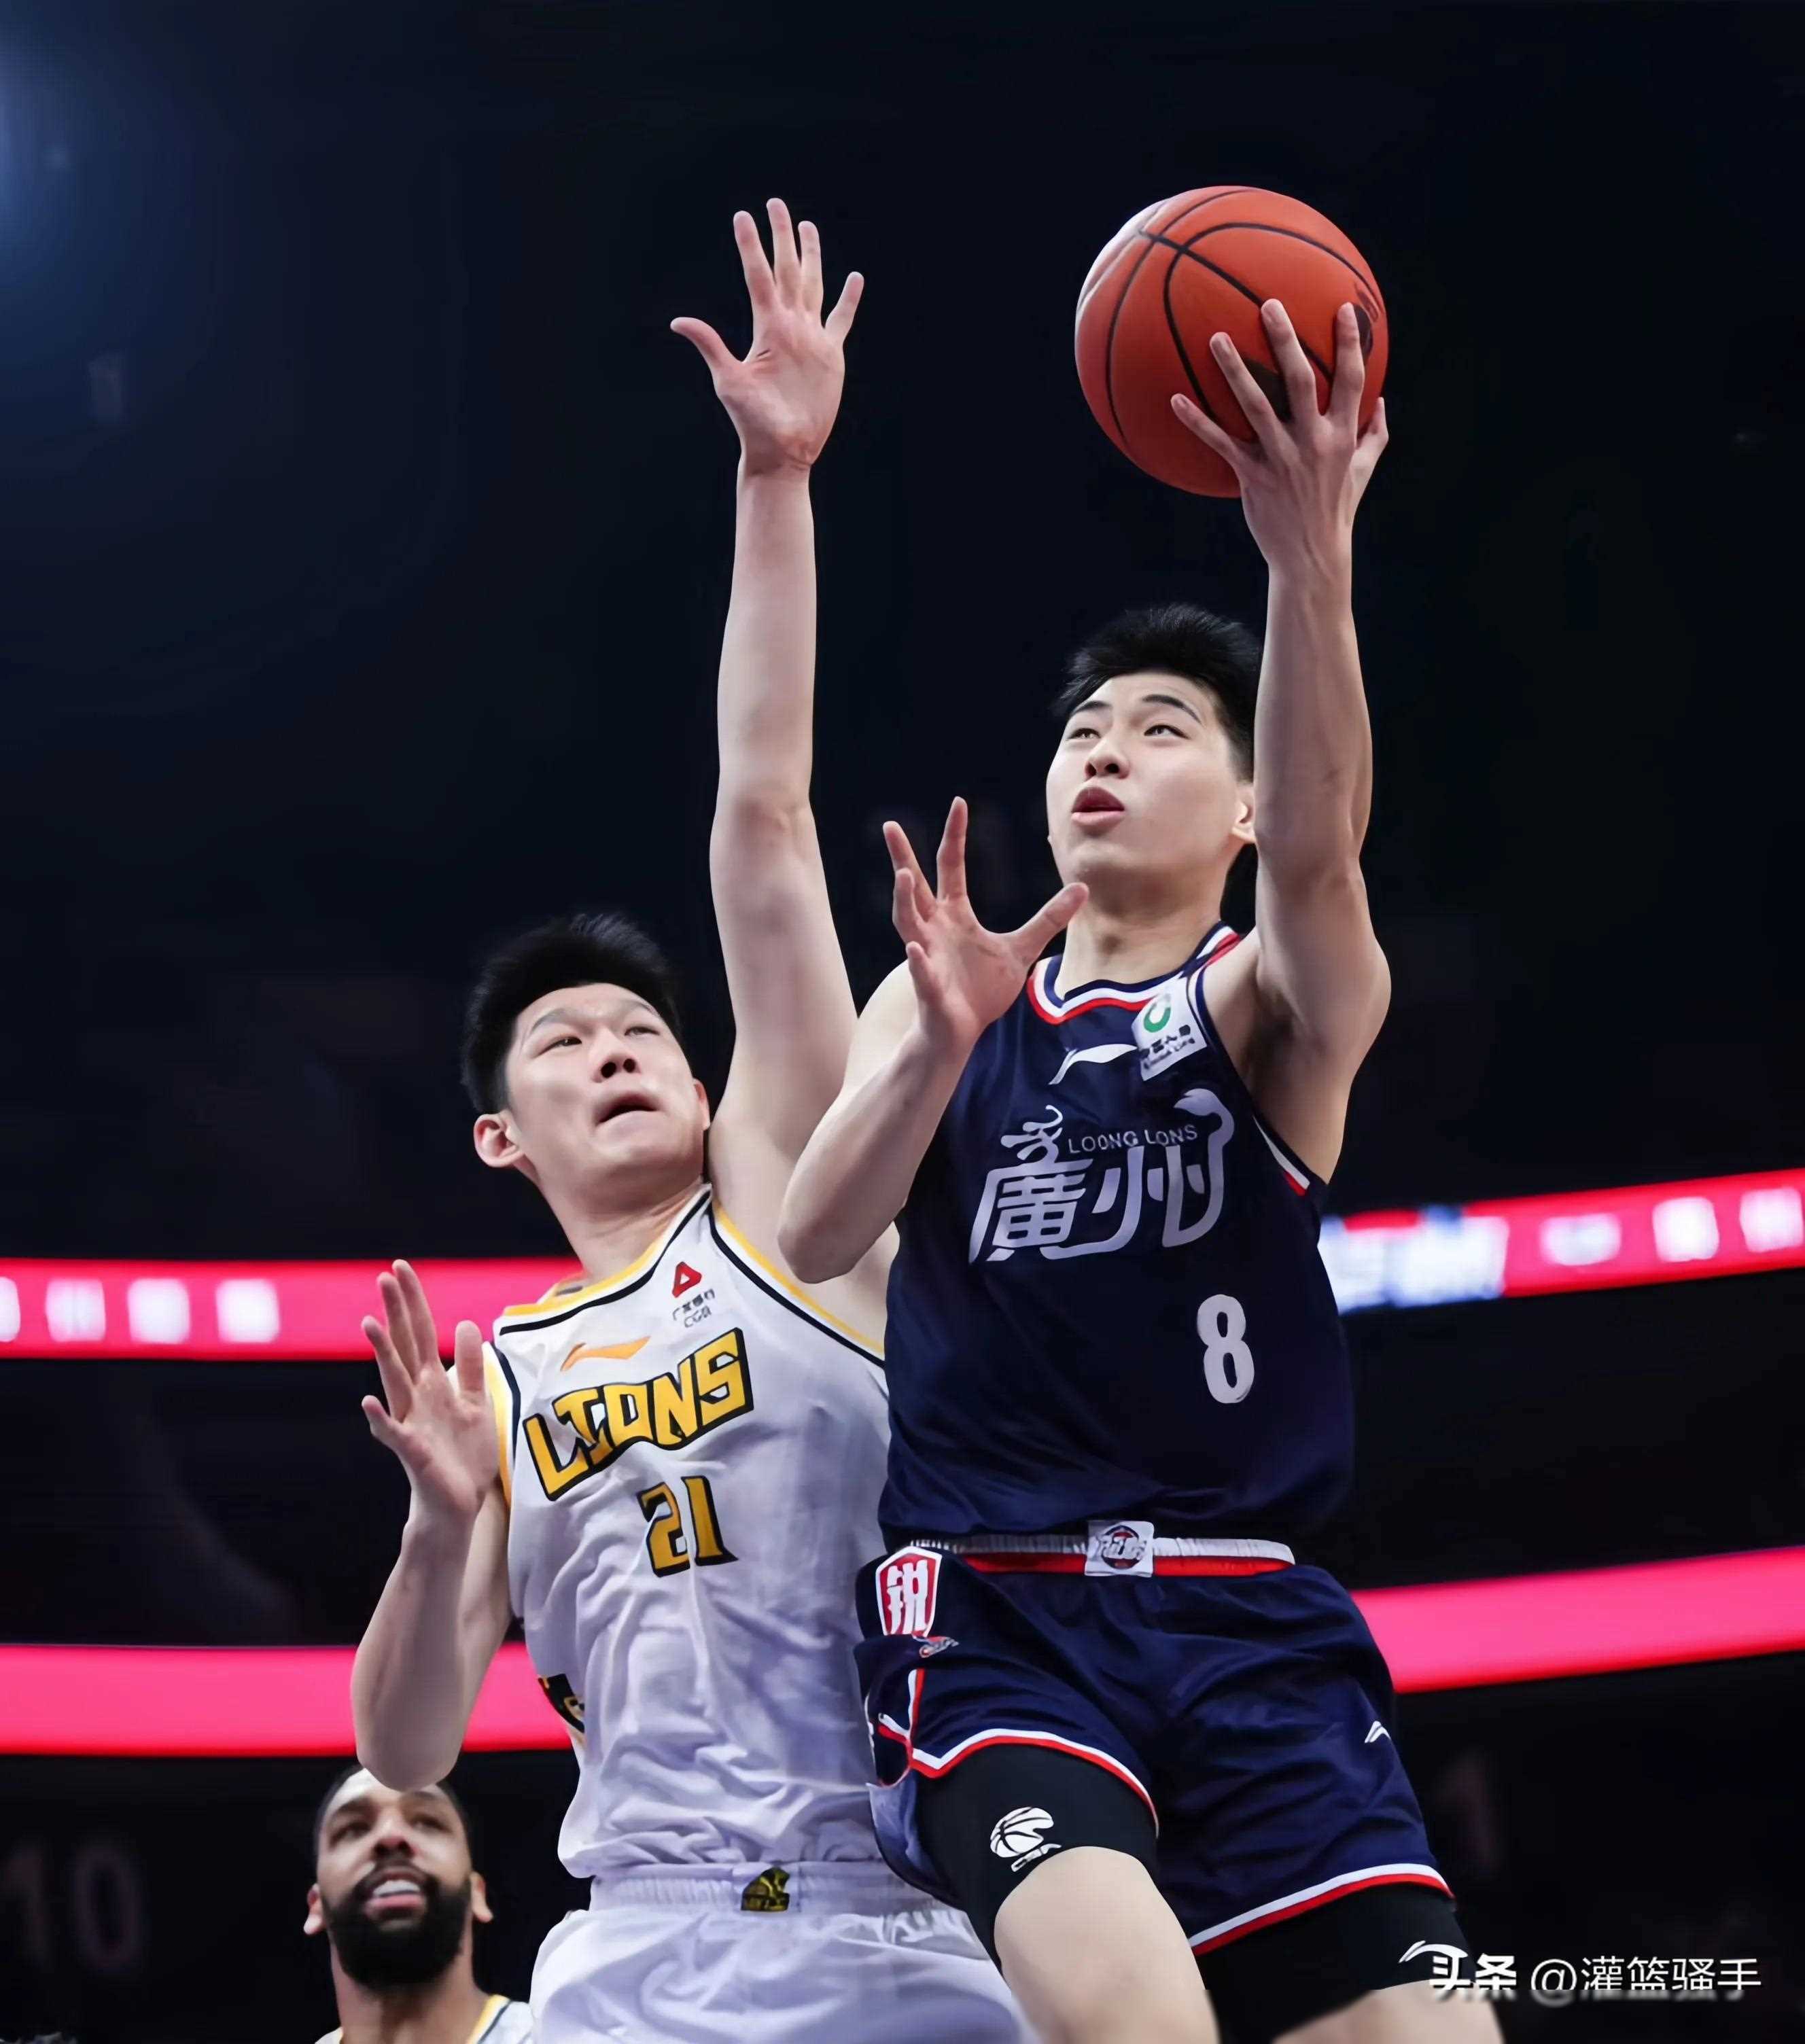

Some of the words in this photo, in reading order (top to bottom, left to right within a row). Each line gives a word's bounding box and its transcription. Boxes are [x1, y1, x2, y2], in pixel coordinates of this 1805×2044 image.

[1068, 1131, 1139, 1154] LOONG
[1197, 1293, 1255, 1404] 8
[523, 1327, 754, 1502] LIONS
[637, 1475, 739, 1578] 21
